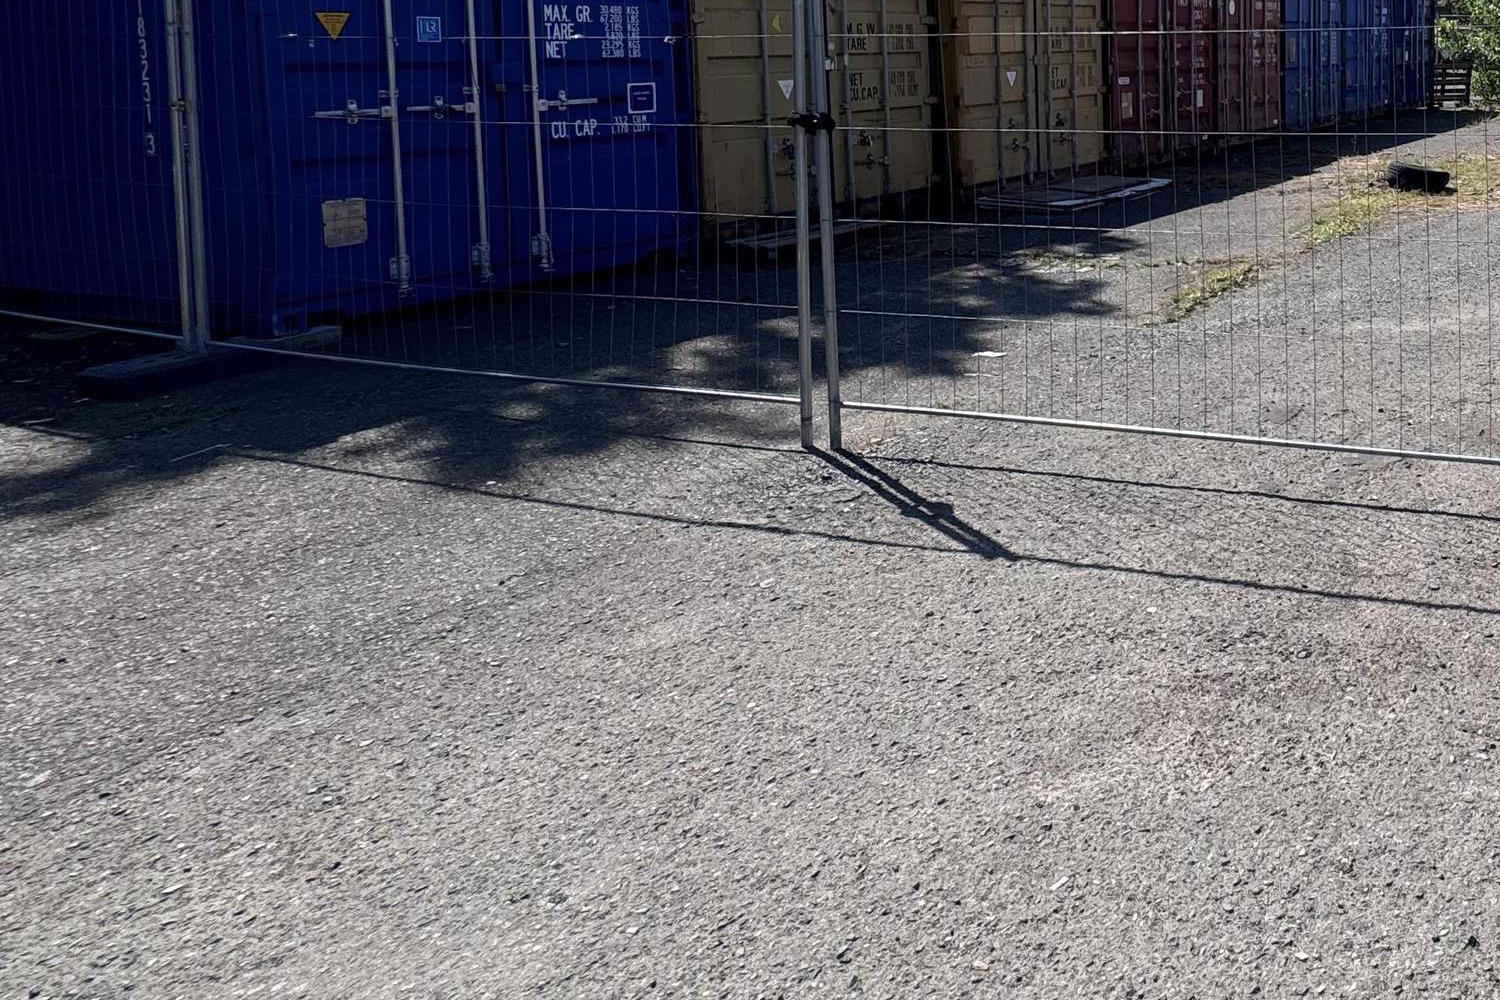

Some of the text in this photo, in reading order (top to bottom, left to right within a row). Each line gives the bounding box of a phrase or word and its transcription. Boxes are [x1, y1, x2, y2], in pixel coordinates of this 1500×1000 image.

[544, 4, 593, 23] MAX. GR.
[545, 23, 575, 40] TARE
[545, 41, 568, 58] NET
[575, 118, 600, 136] CAP.
